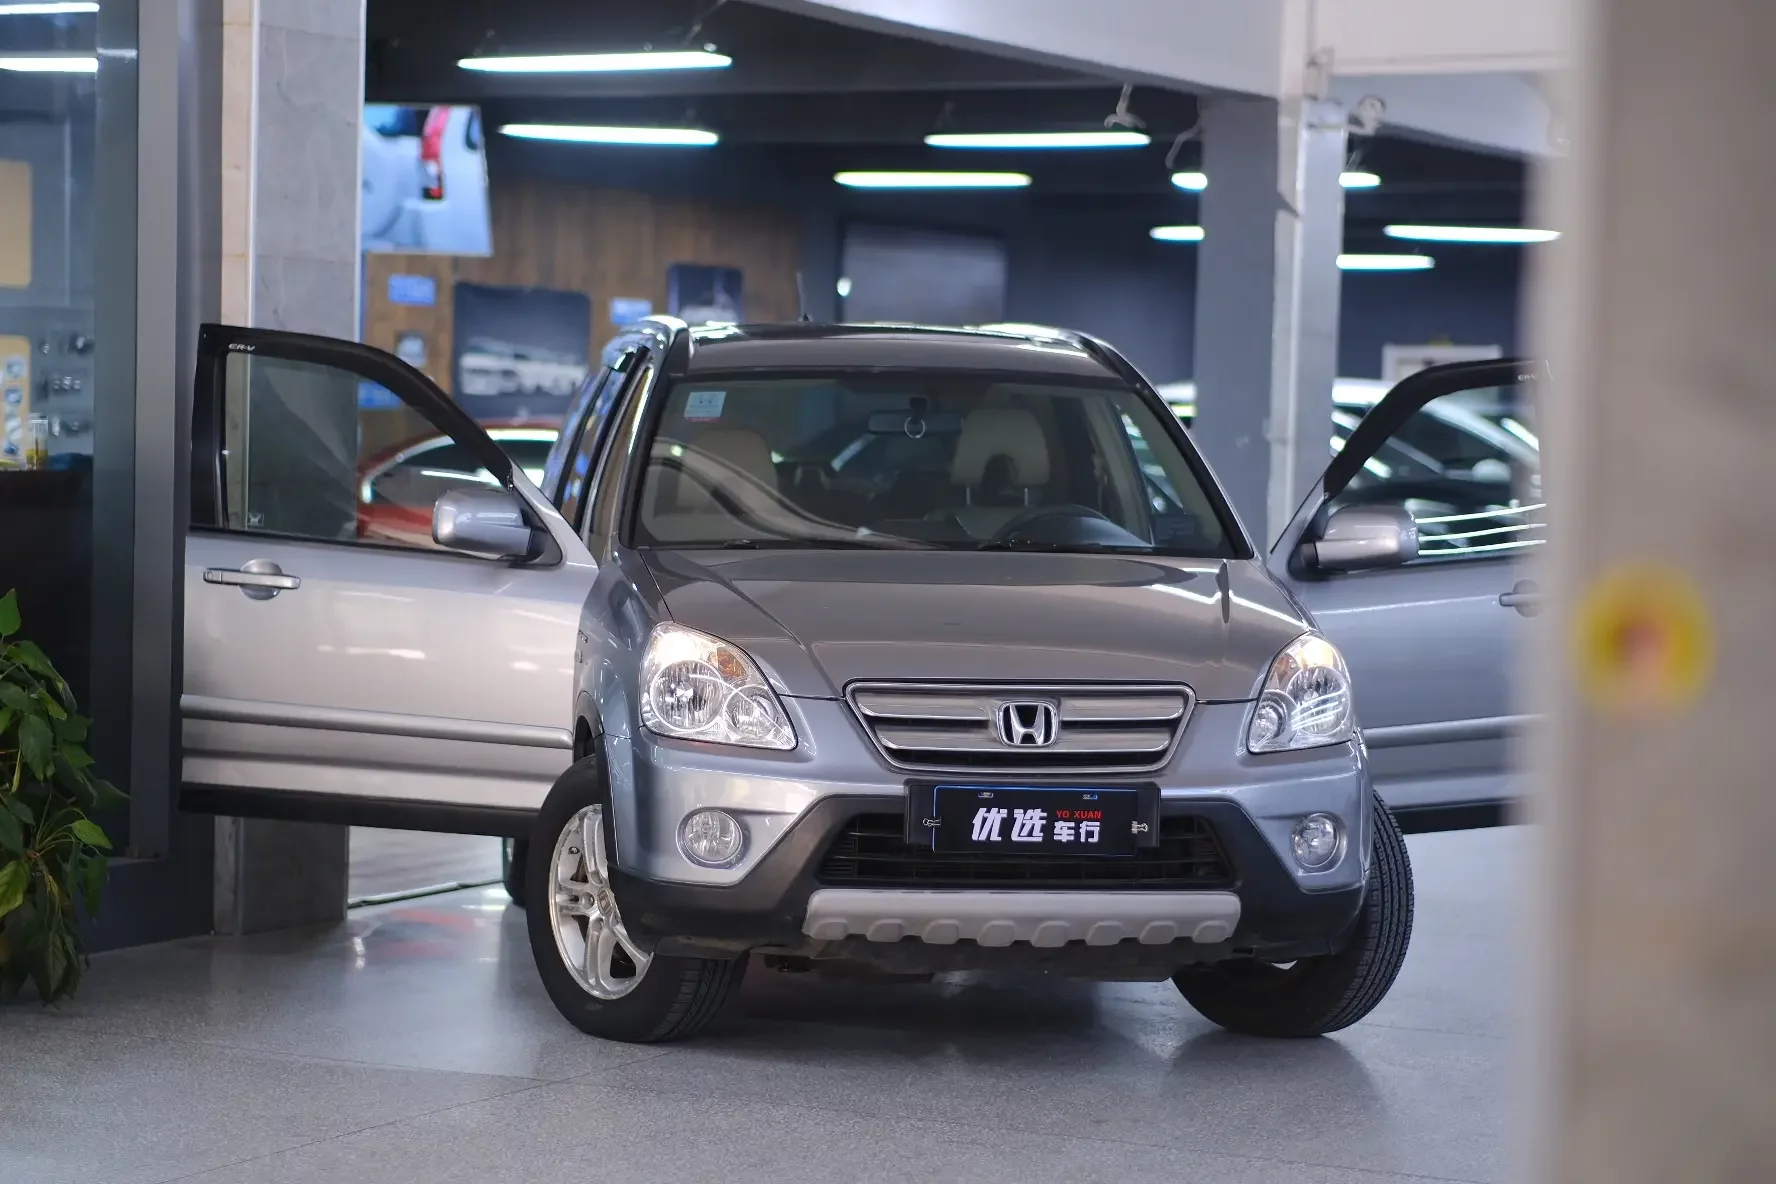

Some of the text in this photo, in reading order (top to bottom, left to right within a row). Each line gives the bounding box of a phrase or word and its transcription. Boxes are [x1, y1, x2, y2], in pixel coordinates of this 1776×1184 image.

[971, 807, 1101, 843] 优选 车行
[1056, 810, 1102, 819] YO XUAN
